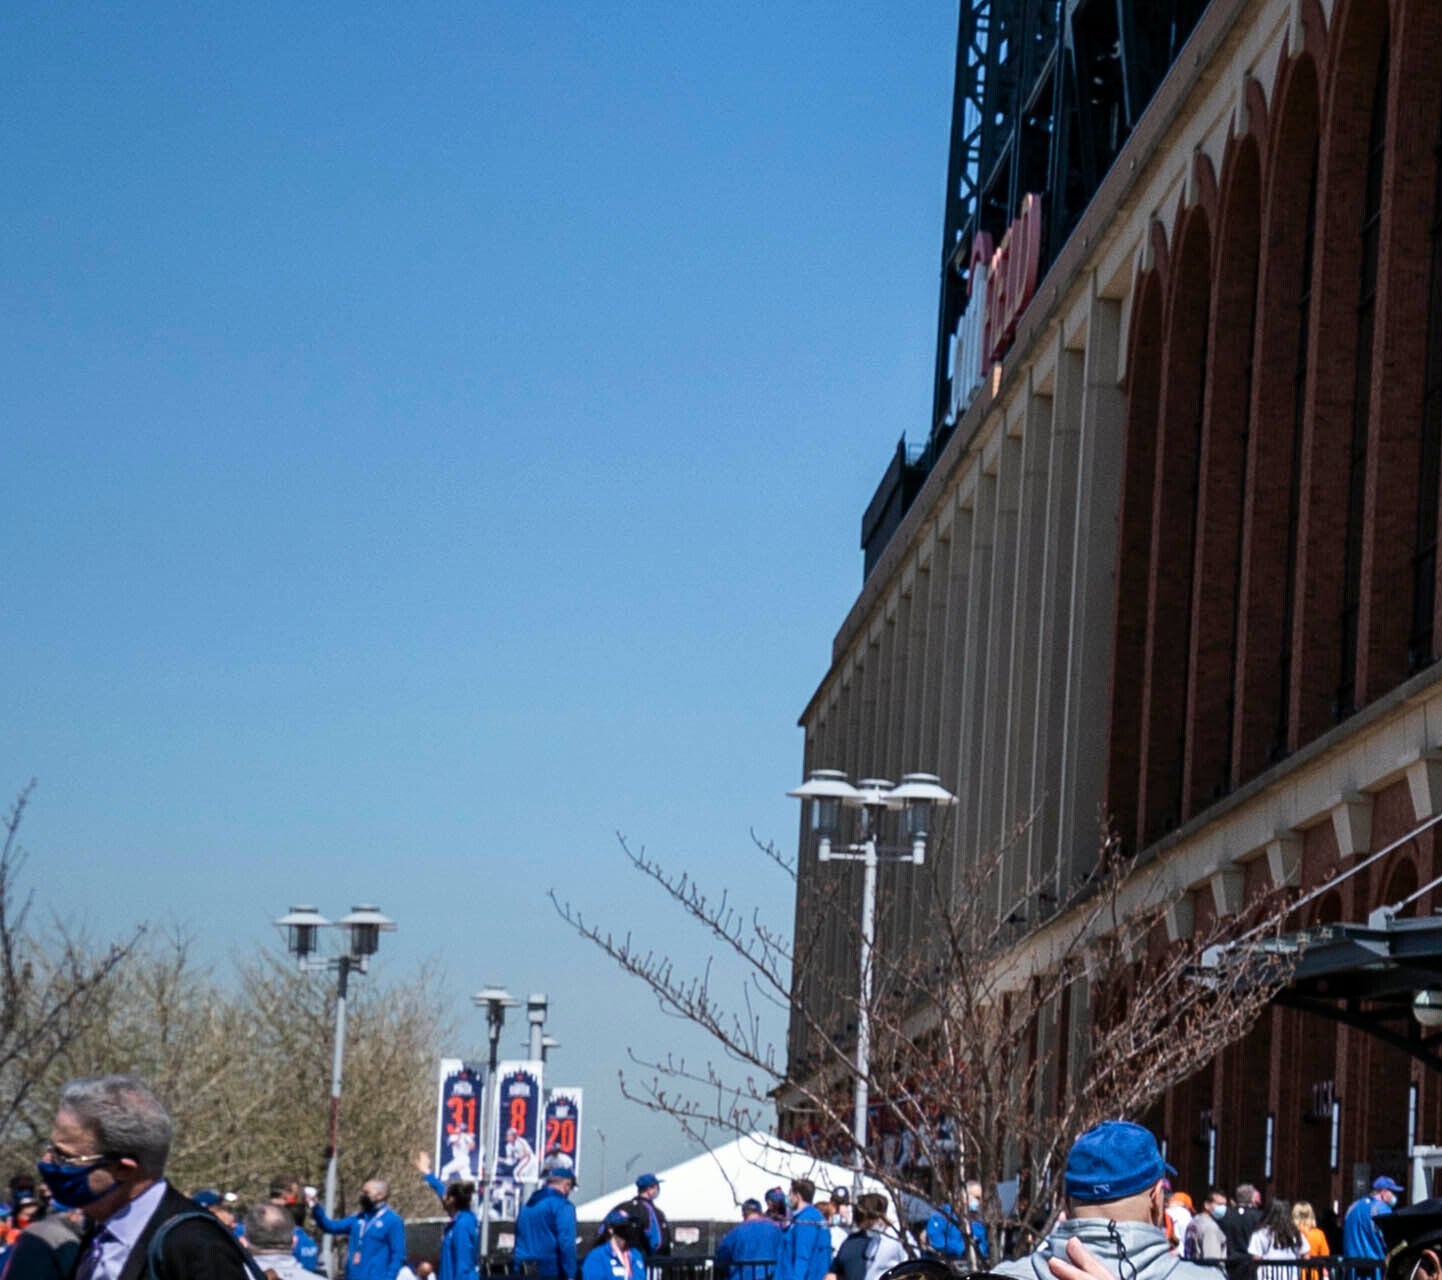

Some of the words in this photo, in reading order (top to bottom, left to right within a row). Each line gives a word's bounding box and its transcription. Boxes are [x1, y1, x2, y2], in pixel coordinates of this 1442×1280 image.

[446, 1096, 476, 1134] 31
[510, 1097, 527, 1136] 8
[546, 1119, 575, 1153] 20
